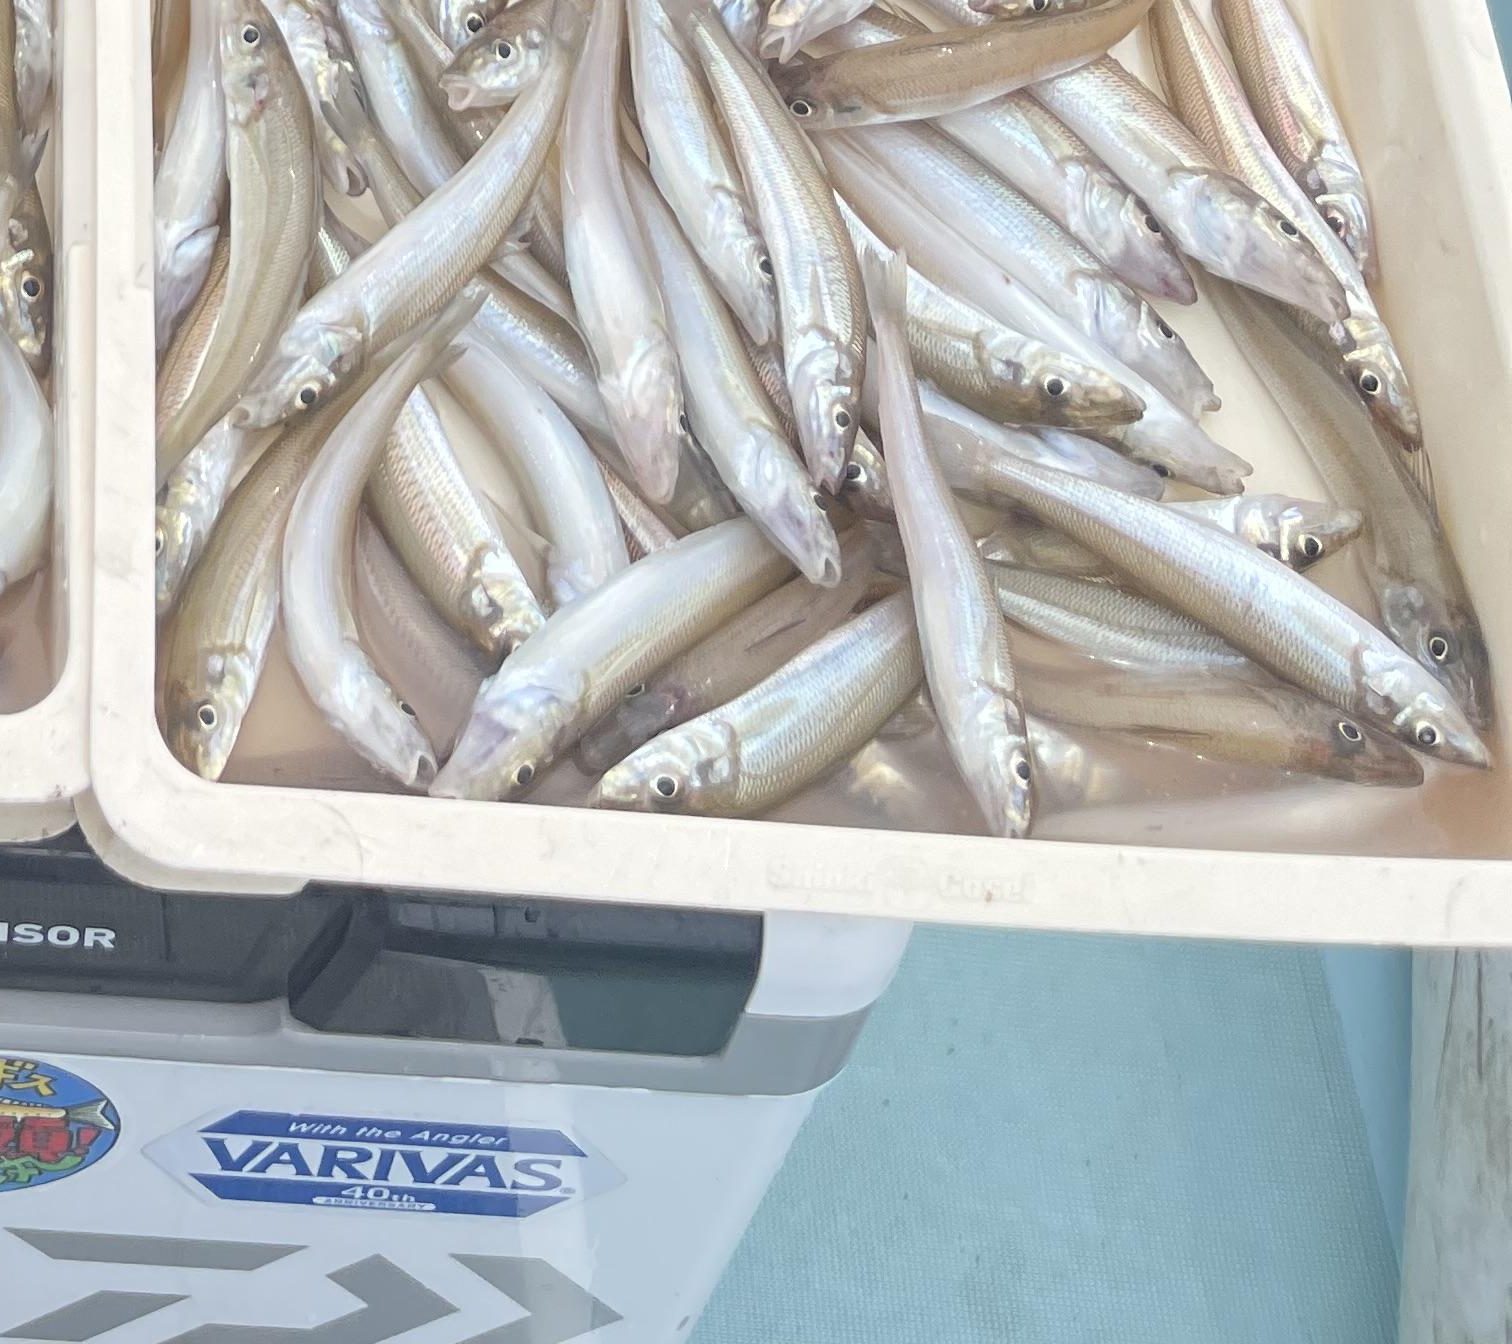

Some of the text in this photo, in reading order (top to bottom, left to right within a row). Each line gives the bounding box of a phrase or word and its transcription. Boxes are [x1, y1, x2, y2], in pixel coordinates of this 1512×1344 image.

[288, 1120, 509, 1147] With the Angler
[201, 1136, 563, 1192] VARIVAS
[341, 1185, 417, 1203] 40th
